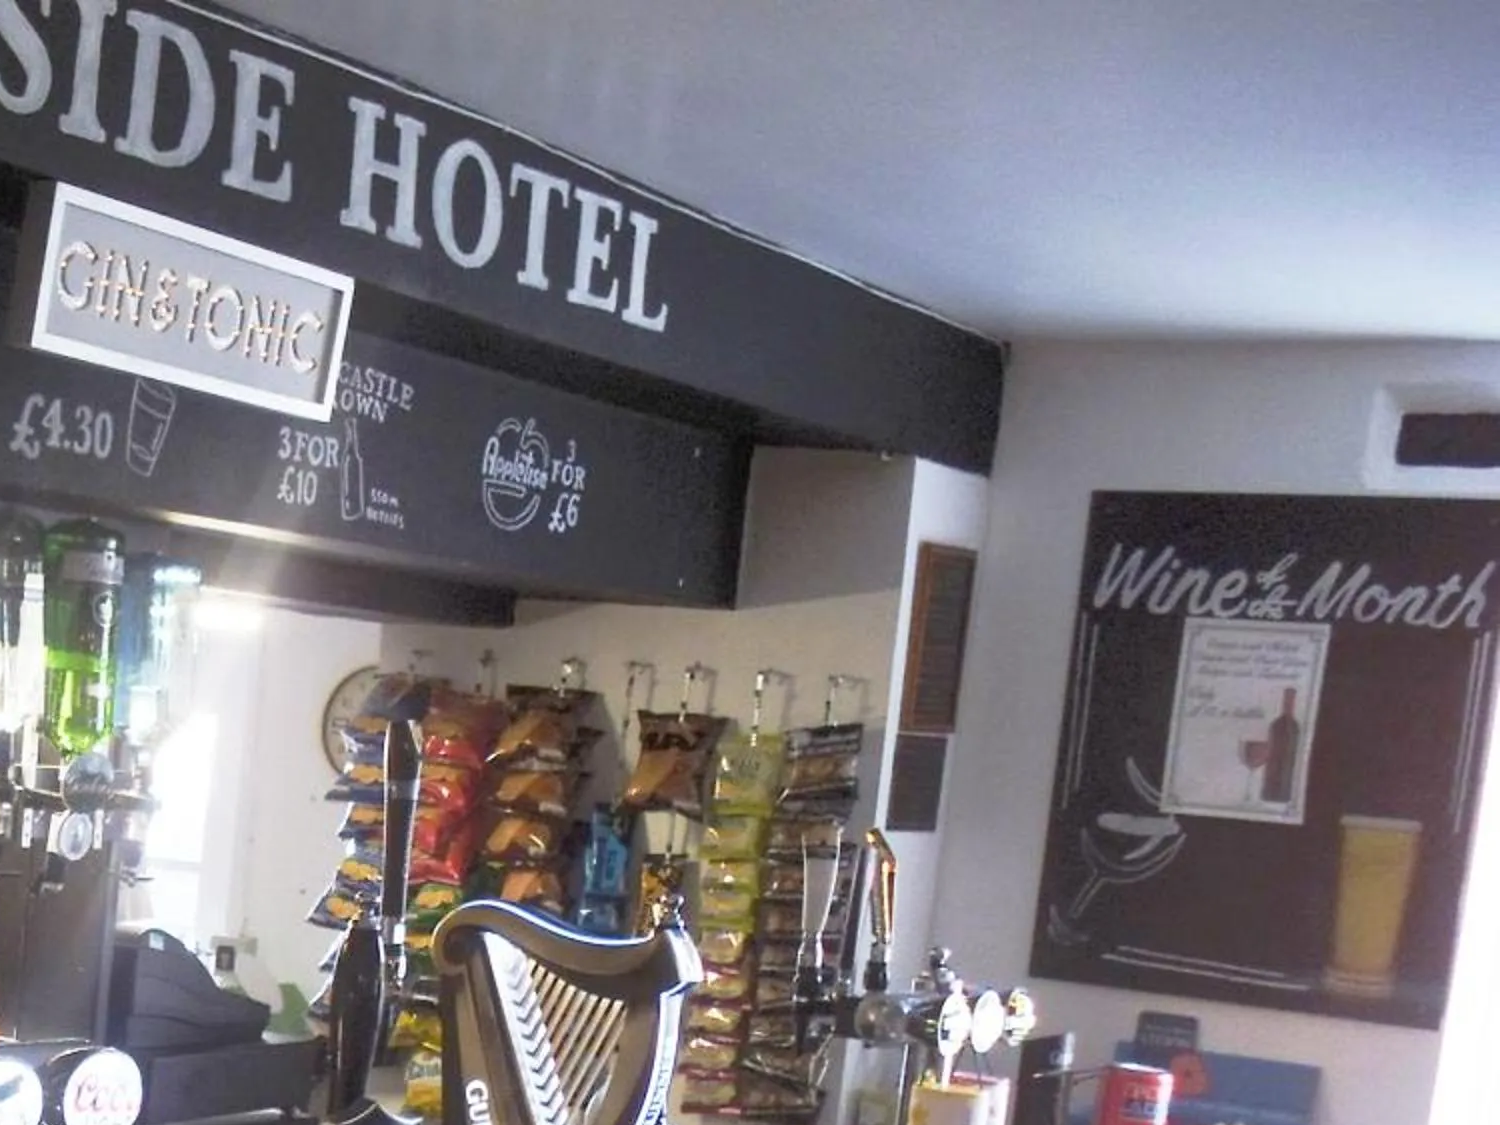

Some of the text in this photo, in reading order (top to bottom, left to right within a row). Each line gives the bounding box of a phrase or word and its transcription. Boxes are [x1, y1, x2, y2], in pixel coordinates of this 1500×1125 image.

[339, 96, 669, 334] HOTEL
[9, 393, 114, 459] £4.30
[332, 388, 389, 422] OWN
[277, 425, 340, 469] 3 FOR
[276, 466, 318, 506] £10
[551, 457, 586, 492] FOR
[547, 492, 581, 534] £6
[1092, 542, 1250, 618] Wine
[1297, 560, 1498, 630] Month
